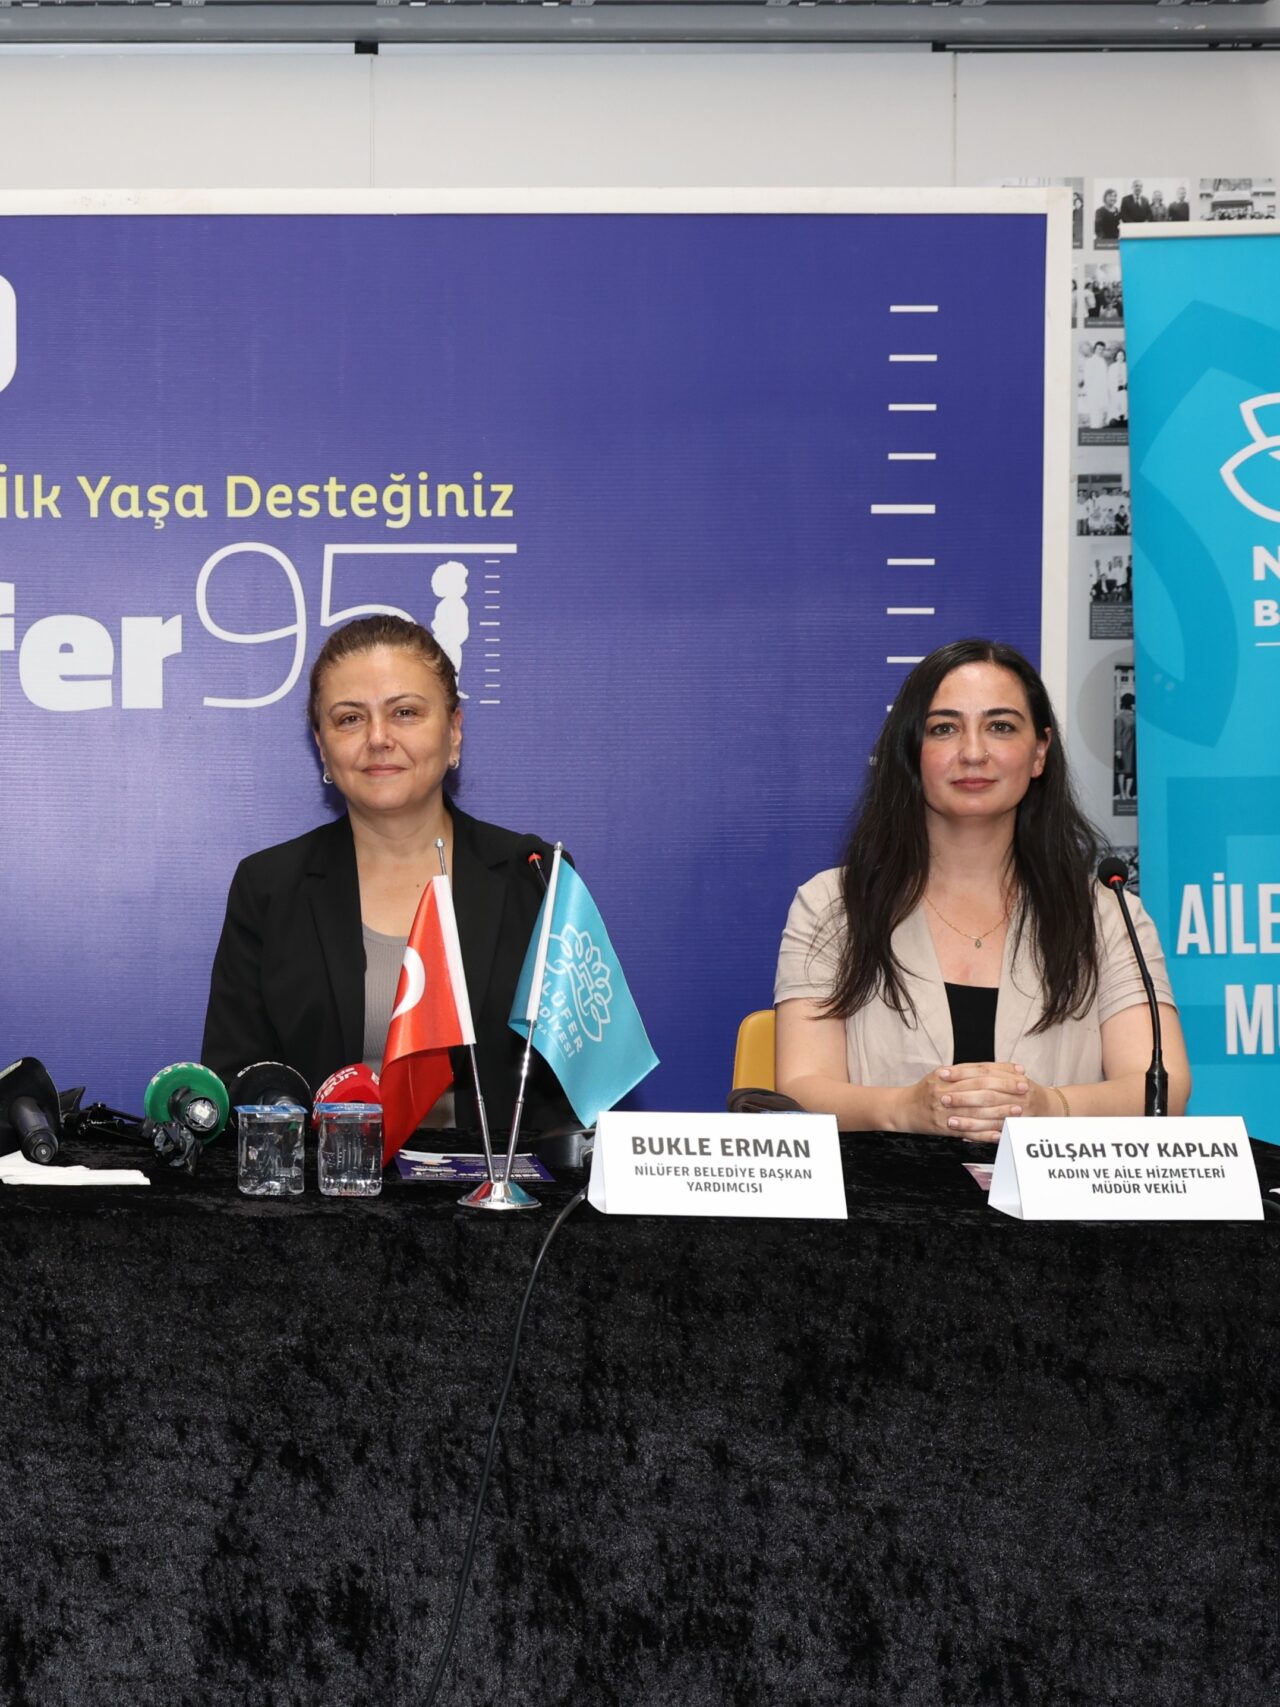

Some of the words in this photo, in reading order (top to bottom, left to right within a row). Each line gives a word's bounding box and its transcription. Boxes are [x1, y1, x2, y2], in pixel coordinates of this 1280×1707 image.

[77, 473, 208, 530] Yaşa
[225, 470, 515, 529] Desteğiniz
[1176, 872, 1280, 955] AİLE
[541, 974, 584, 1053] LÜFER
[1224, 983, 1280, 1056] M
[631, 1136, 712, 1157] BUKLE
[720, 1137, 811, 1158] ERMAN
[1025, 1139, 1106, 1163] GÜLŞAH
[1111, 1142, 1150, 1158] TOY
[1157, 1142, 1239, 1158] KAPLAN
[634, 1162, 691, 1177] NİLÜFER
[693, 1164, 756, 1178] BELEDİYE
[759, 1168, 812, 1181] BAŞKAN
[1047, 1168, 1090, 1179] KADIN
[1093, 1168, 1111, 1179] VE
[1114, 1165, 1143, 1179] AİLE
[1146, 1164, 1226, 1179] HİZMETLERİ
[687, 1181, 763, 1194] YARDIMCISI
[1092, 1180, 1141, 1194] MÜDÜR
[1143, 1179, 1187, 1194] VEKİLİ
